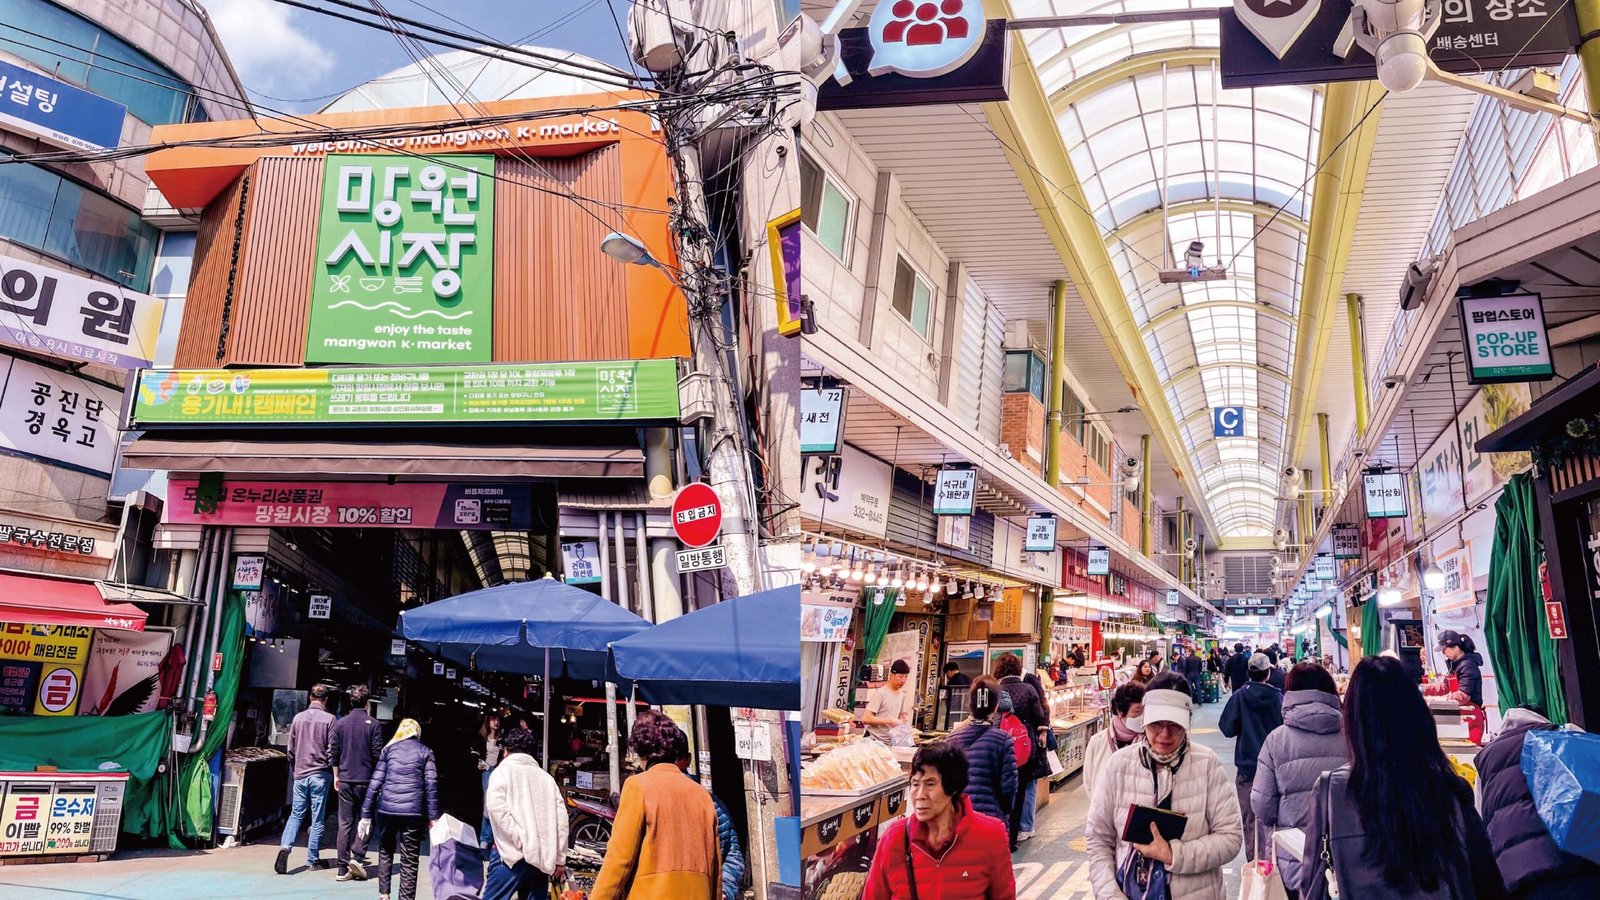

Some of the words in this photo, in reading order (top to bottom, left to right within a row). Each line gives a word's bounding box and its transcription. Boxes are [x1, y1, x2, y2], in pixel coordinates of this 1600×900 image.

[1436, 32, 1499, 50] 배송센터
[409, 127, 511, 148] mangwon
[337, 164, 478, 227] 망원
[325, 229, 475, 299] 시장
[1471, 308, 1536, 323] 팝업스토어
[374, 324, 409, 335] enjoy
[413, 324, 434, 335] the
[437, 325, 472, 336] taste
[1475, 331, 1538, 345] POP-UP
[324, 336, 396, 350] mangwon
[1478, 343, 1540, 357] STORE
[72, 344, 119, 366] 진료시작
[828, 393, 840, 401] 72
[1219, 407, 1239, 429] C
[943, 480, 967, 489] 석규네
[1368, 488, 1401, 498] 부자상회
[231, 488, 324, 503] 온누리상품권
[938, 490, 970, 500] 수제한과
[255, 505, 331, 524] 망원시장
[337, 507, 376, 523] 10%
[380, 507, 412, 524] 할인
[677, 505, 716, 523] 진입금지
[853, 506, 883, 524] 332-8445
[679, 550, 724, 567] 일방통행
[33, 643, 78, 659] 매입전문
[15, 797, 40, 820] 금
[52, 797, 95, 817] 은수저
[5, 822, 41, 839] 이빨
[50, 822, 71, 834] 99%
